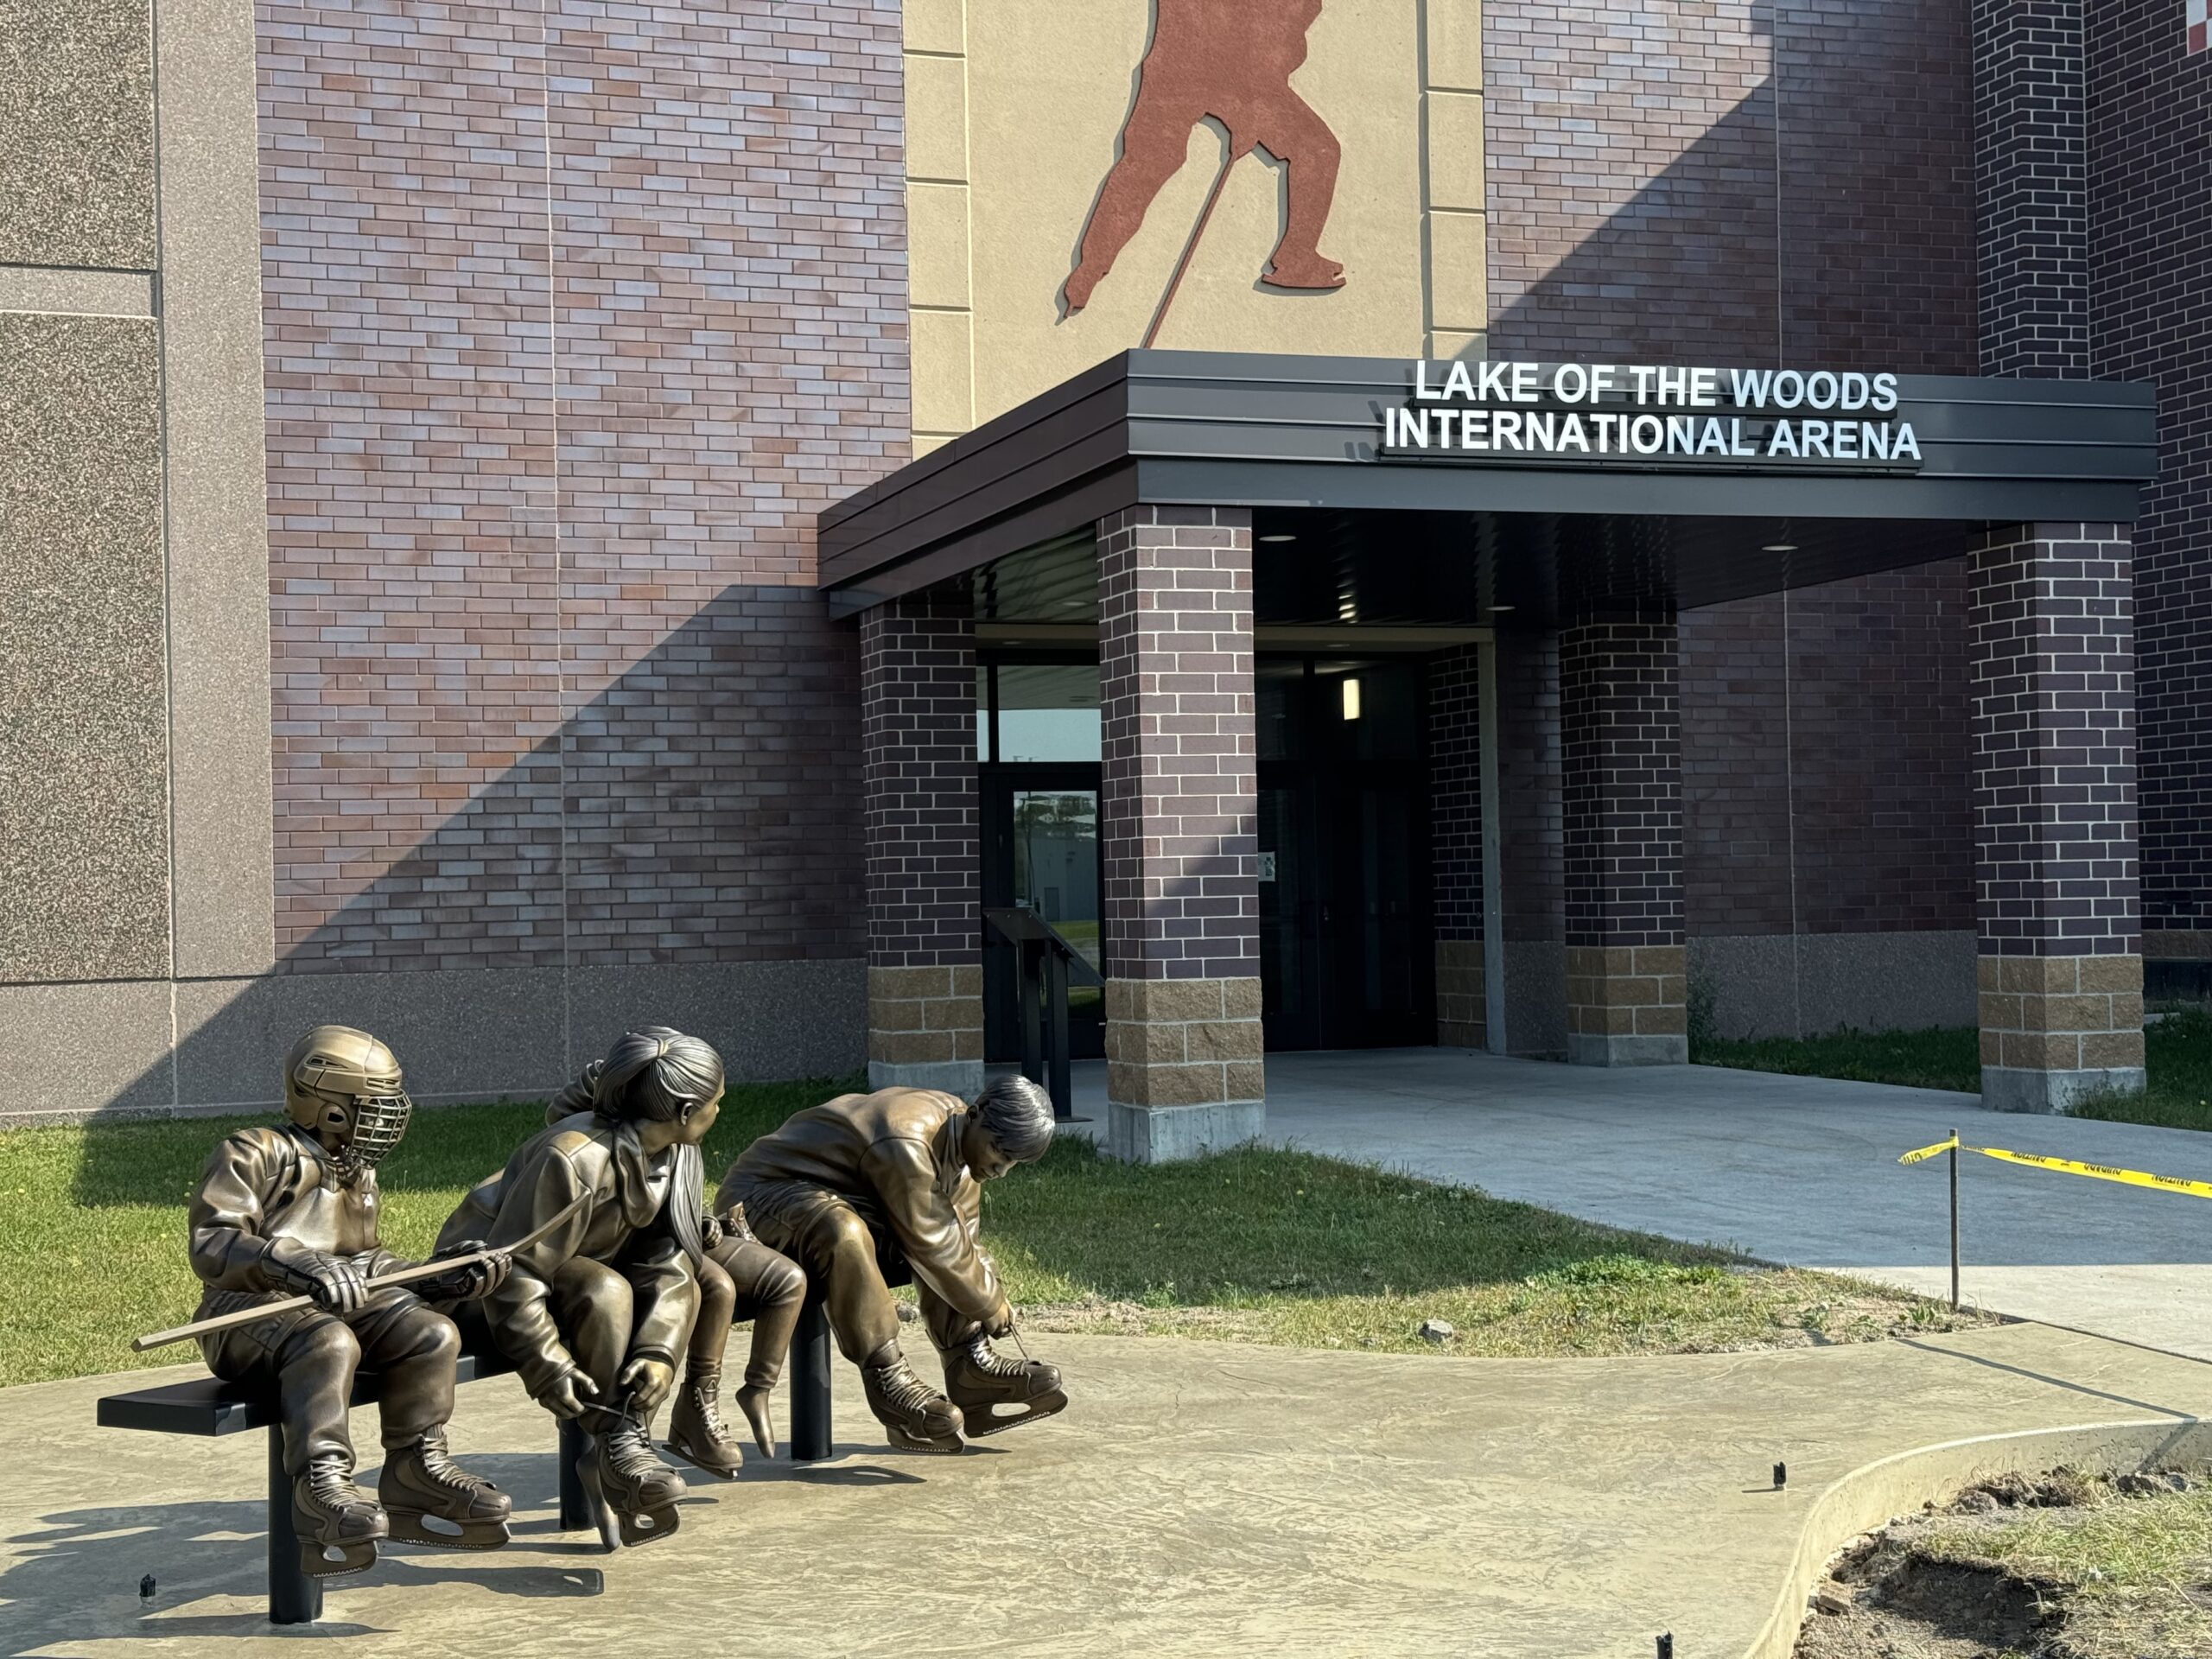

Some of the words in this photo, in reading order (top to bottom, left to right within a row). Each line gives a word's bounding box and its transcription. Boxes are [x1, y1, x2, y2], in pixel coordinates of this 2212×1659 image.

[1416, 359, 1539, 402] LAKE
[1554, 363, 1616, 404] OF
[1629, 365, 1716, 406] THE
[1731, 368, 1898, 411] WOODS
[1385, 407, 1755, 456] INTERNATIONAL
[1767, 419, 1923, 461] ARENA
